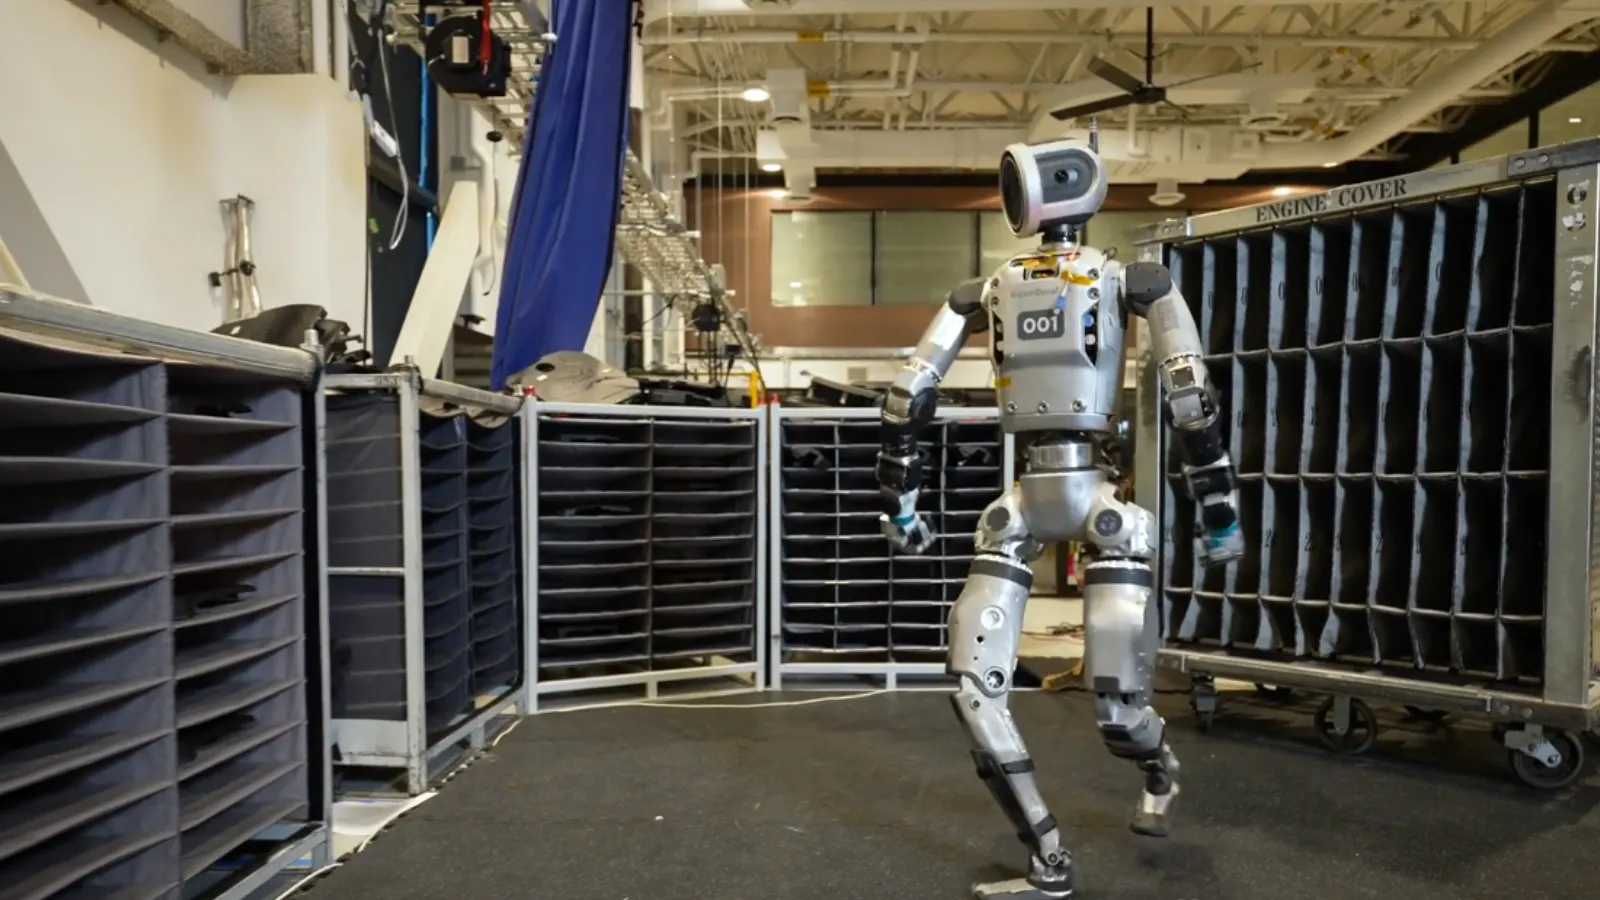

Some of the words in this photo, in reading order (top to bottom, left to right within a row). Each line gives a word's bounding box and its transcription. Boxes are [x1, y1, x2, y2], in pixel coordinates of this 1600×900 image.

[1256, 194, 1327, 222] ENGINE
[1338, 178, 1407, 207] COVER
[1023, 316, 1058, 334] 001
